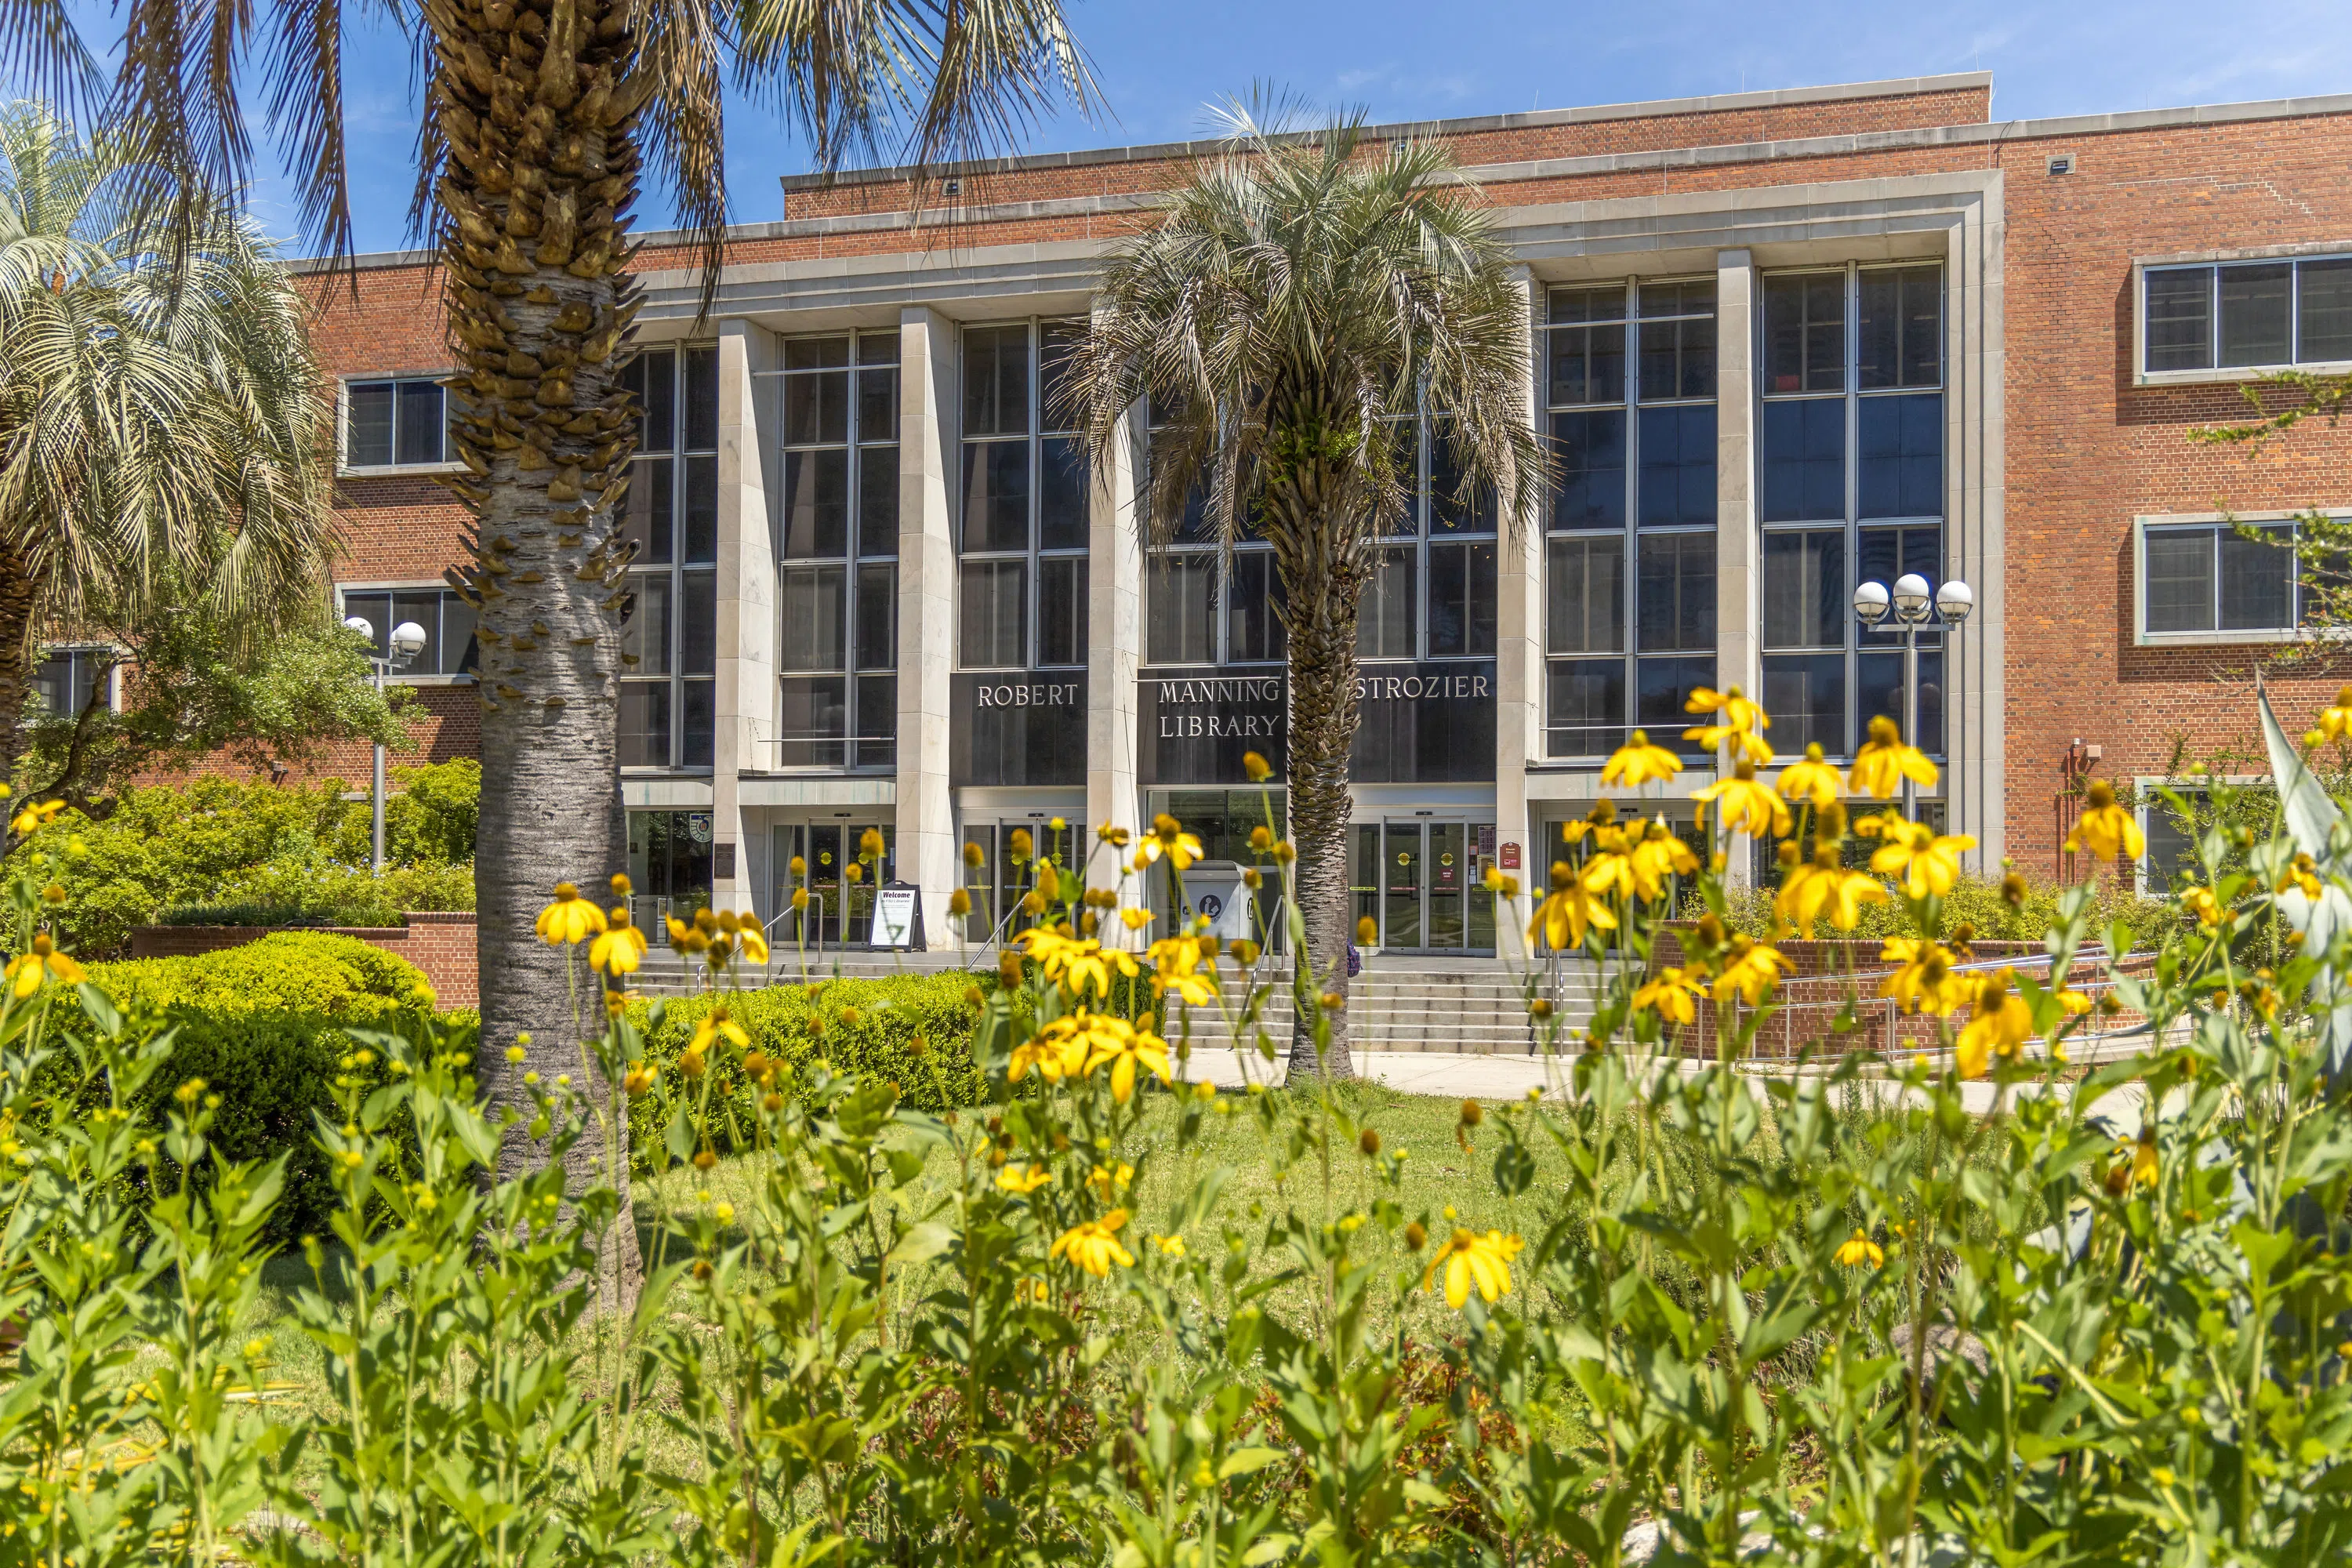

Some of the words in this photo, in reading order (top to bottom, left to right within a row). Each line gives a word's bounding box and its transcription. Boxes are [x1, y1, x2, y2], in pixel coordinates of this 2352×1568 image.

[978, 684, 1079, 707] ROBERT
[1160, 680, 1279, 702] MANNING
[1356, 676, 1488, 699] STROZIER
[1160, 715, 1280, 738] LIBRARY
